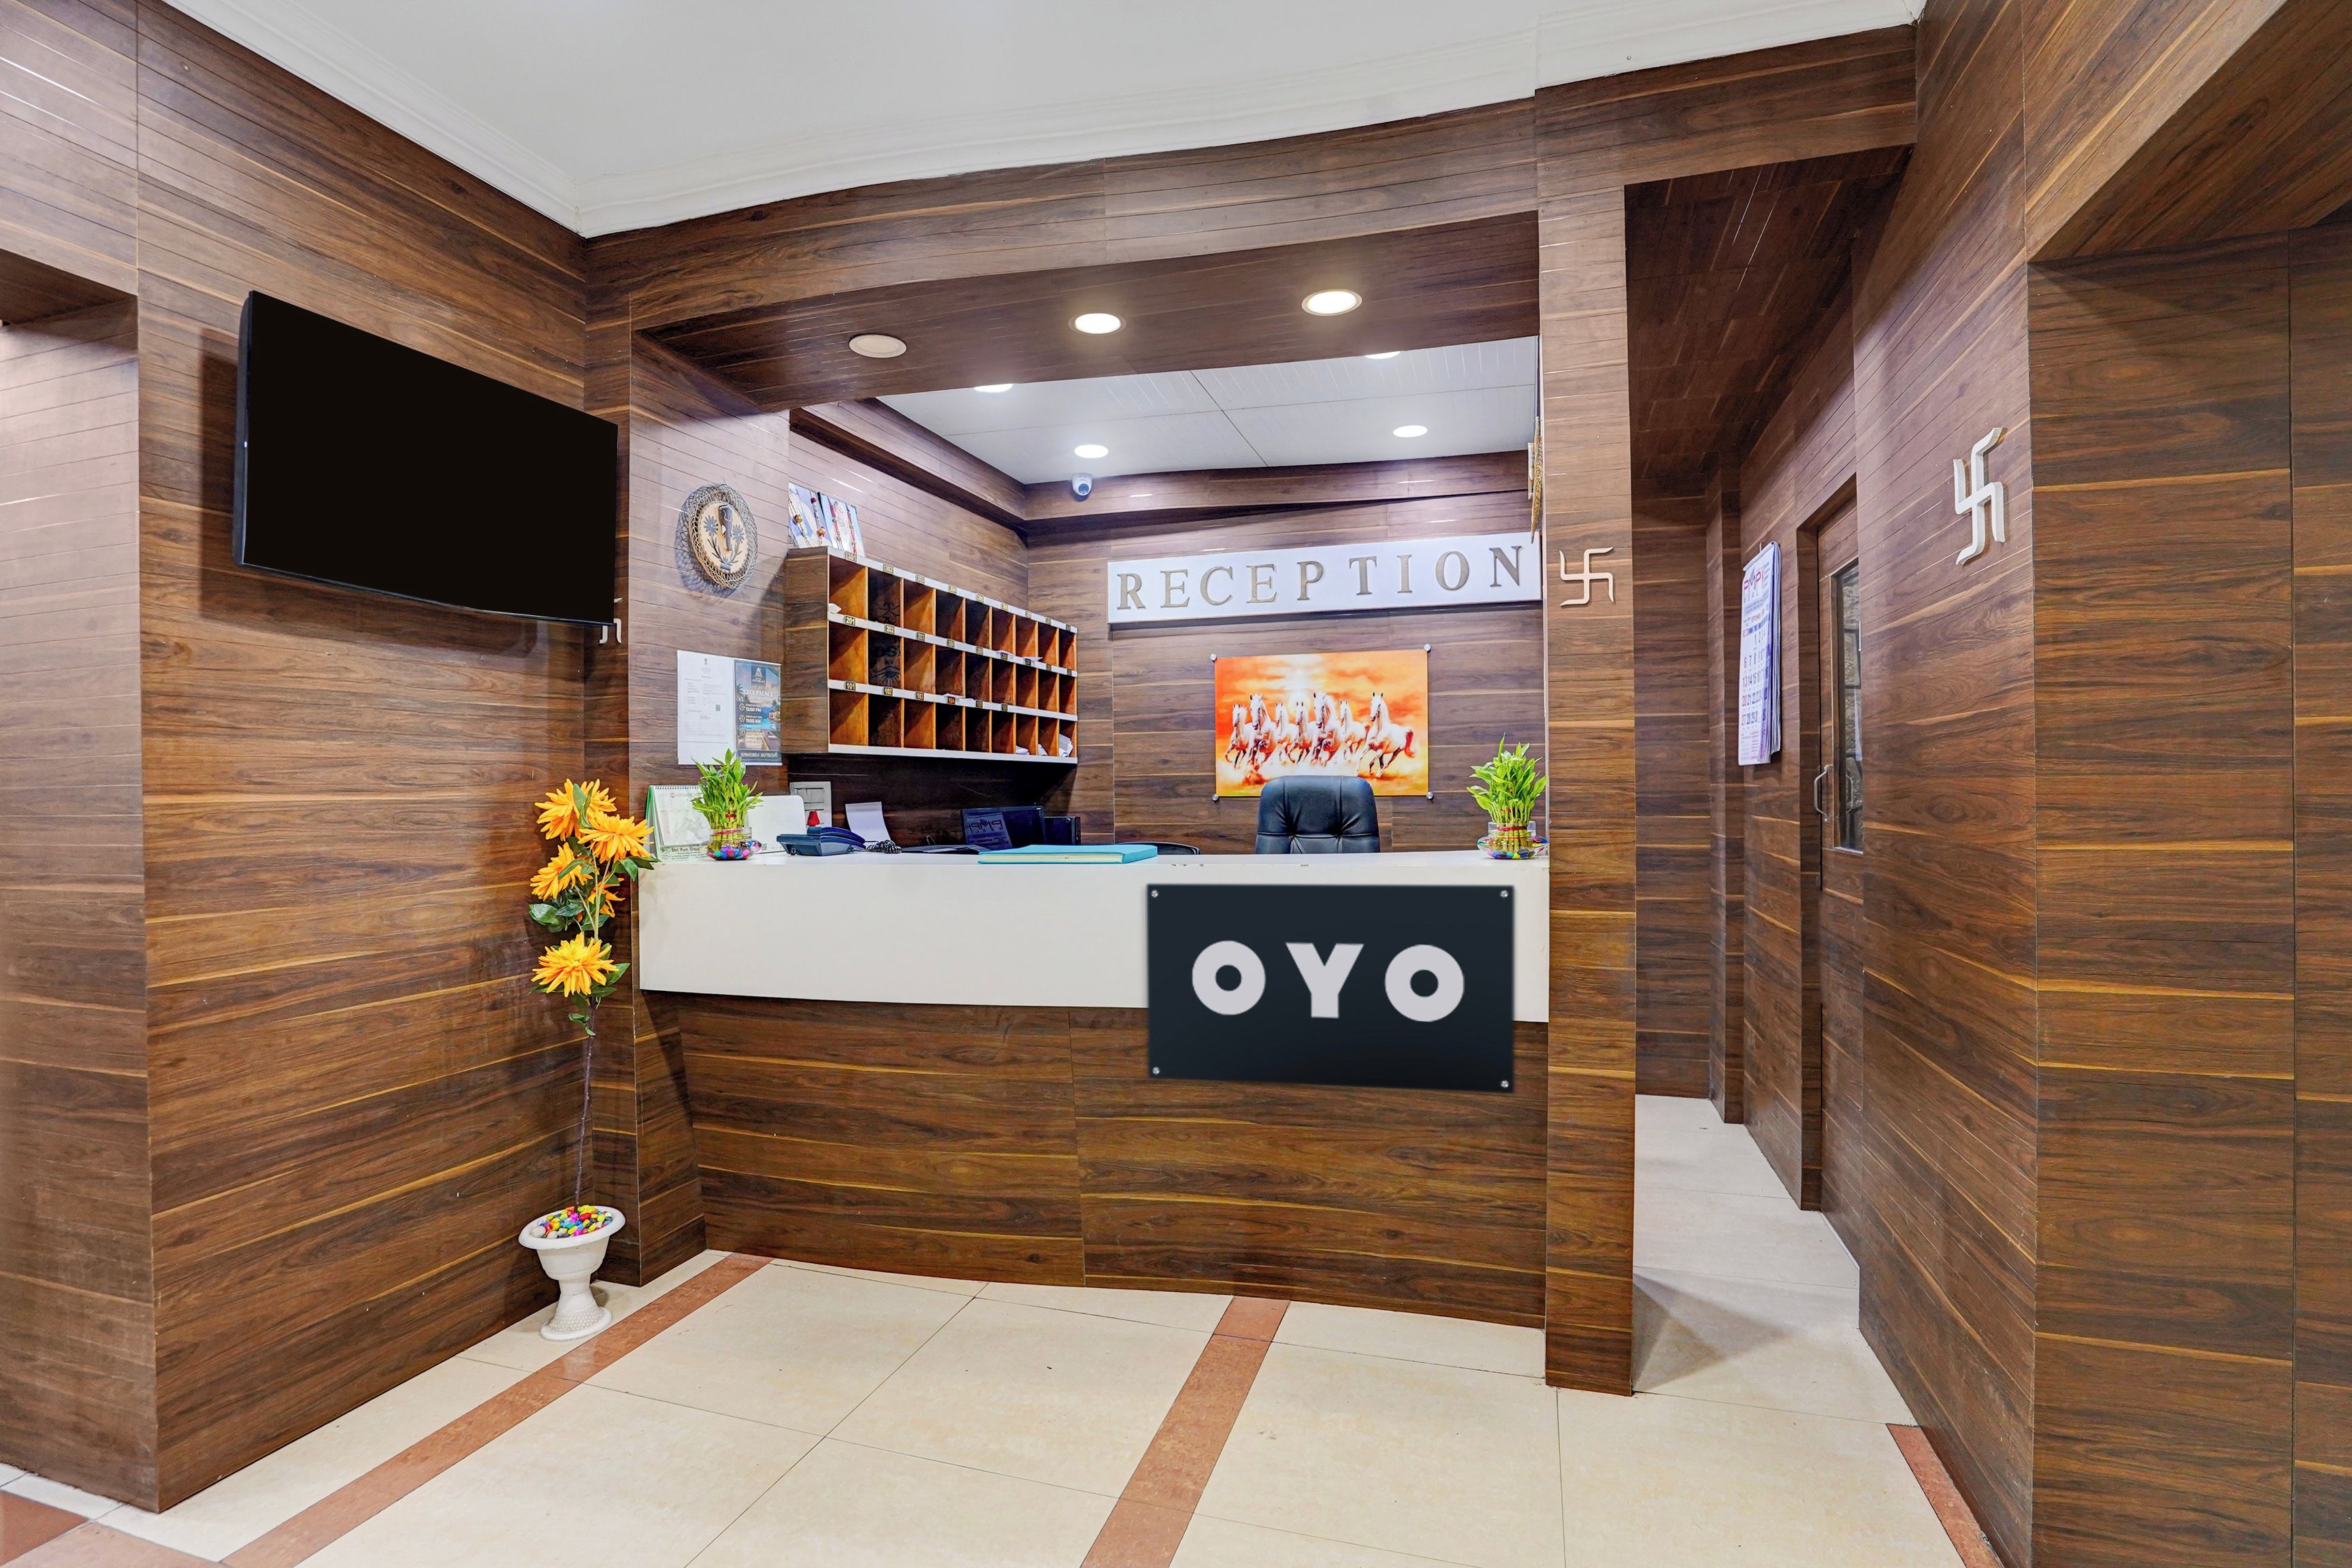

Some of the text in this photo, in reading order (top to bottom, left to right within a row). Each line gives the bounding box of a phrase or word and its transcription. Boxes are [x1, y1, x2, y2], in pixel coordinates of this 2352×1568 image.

[1117, 545, 1522, 610] RECEPTION
[846, 617, 855, 625] 201
[886, 625, 894, 634] 202
[1192, 940, 1465, 1022] OYO
